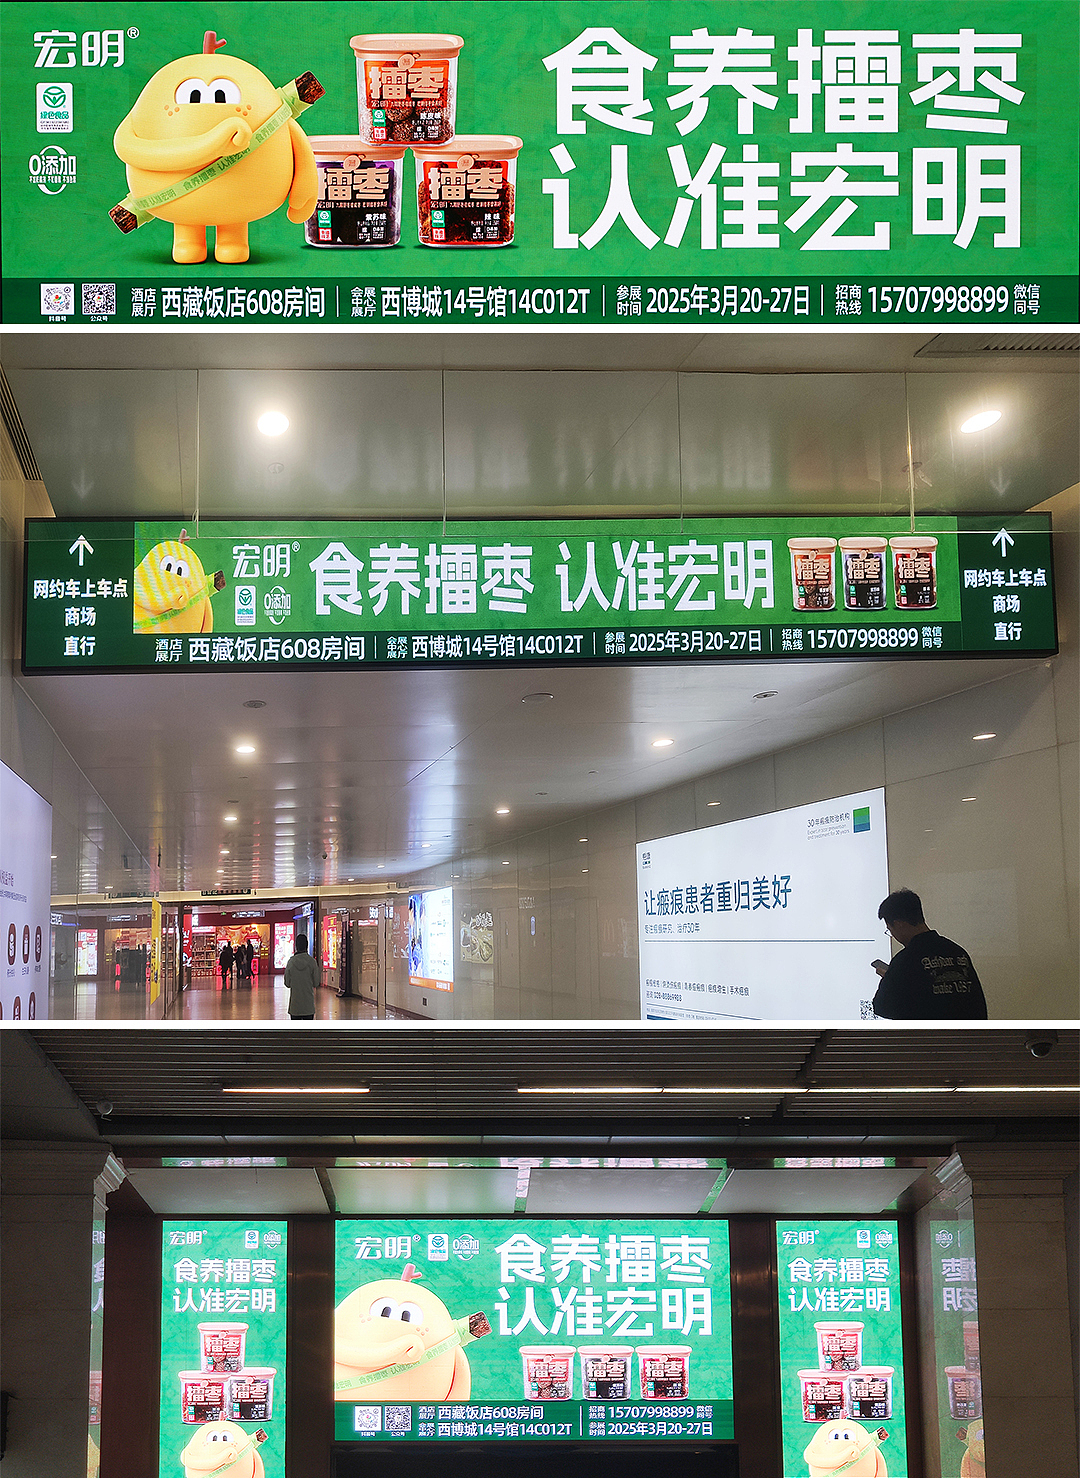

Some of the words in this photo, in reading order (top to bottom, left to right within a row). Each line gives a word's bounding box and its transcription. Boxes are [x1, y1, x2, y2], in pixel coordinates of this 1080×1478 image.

[369, 66, 445, 99] 擂枣
[542, 27, 1026, 135] 食养擂枣
[29, 154, 76, 176] 0添加
[428, 167, 503, 200] 擂枣
[542, 142, 1021, 251] 认准宏明
[131, 288, 156, 301] 酒店
[161, 286, 325, 317] 西藏饭店608房间
[381, 286, 590, 317] 西博城14号馆14C012T
[617, 285, 642, 300] 参展
[647, 285, 810, 316] 2025年3月20-27日
[835, 285, 862, 300] 招商
[868, 286, 1009, 313] 15707998899
[1013, 284, 1040, 299] 微信
[131, 302, 156, 317] 展厅
[617, 301, 642, 316] 时间
[835, 301, 862, 316] 热线
[1013, 300, 1040, 315] 同号
[232, 543, 291, 578] 宏明
[308, 542, 536, 617] 食养擂枣
[555, 538, 774, 612] 认准宏明
[964, 568, 1046, 588] 网约车上车点
[33, 578, 129, 600] 网约车上车点
[993, 594, 1020, 613] 商场
[64, 607, 96, 627] 商场
[629, 629, 762, 653] 2025年3月20-27日
[807, 628, 919, 650] 15707998899
[994, 622, 1021, 641] 直行
[64, 636, 95, 656] 直行
[188, 636, 366, 663] 西藏饭店608房间
[411, 634, 584, 659] 西博城14号馆14C012T
[644, 874, 792, 916] 让瘢痕患者重归美好
[355, 1235, 412, 1260] 宏明
[495, 1233, 712, 1284] 食养擂枣
[173, 1257, 277, 1283] 食养擂枣
[787, 1257, 890, 1283] 食养擂枣
[172, 1287, 277, 1313] 认准宏明
[494, 1286, 711, 1337] 认准宏明
[788, 1287, 891, 1312] 认准宏明
[438, 1405, 544, 1420] 西藏饭店608房间
[608, 1405, 694, 1419] 15707998899
[438, 1421, 572, 1438] 西博城14号馆14C012T
[608, 1421, 713, 1437] 2025年3月20-27日
